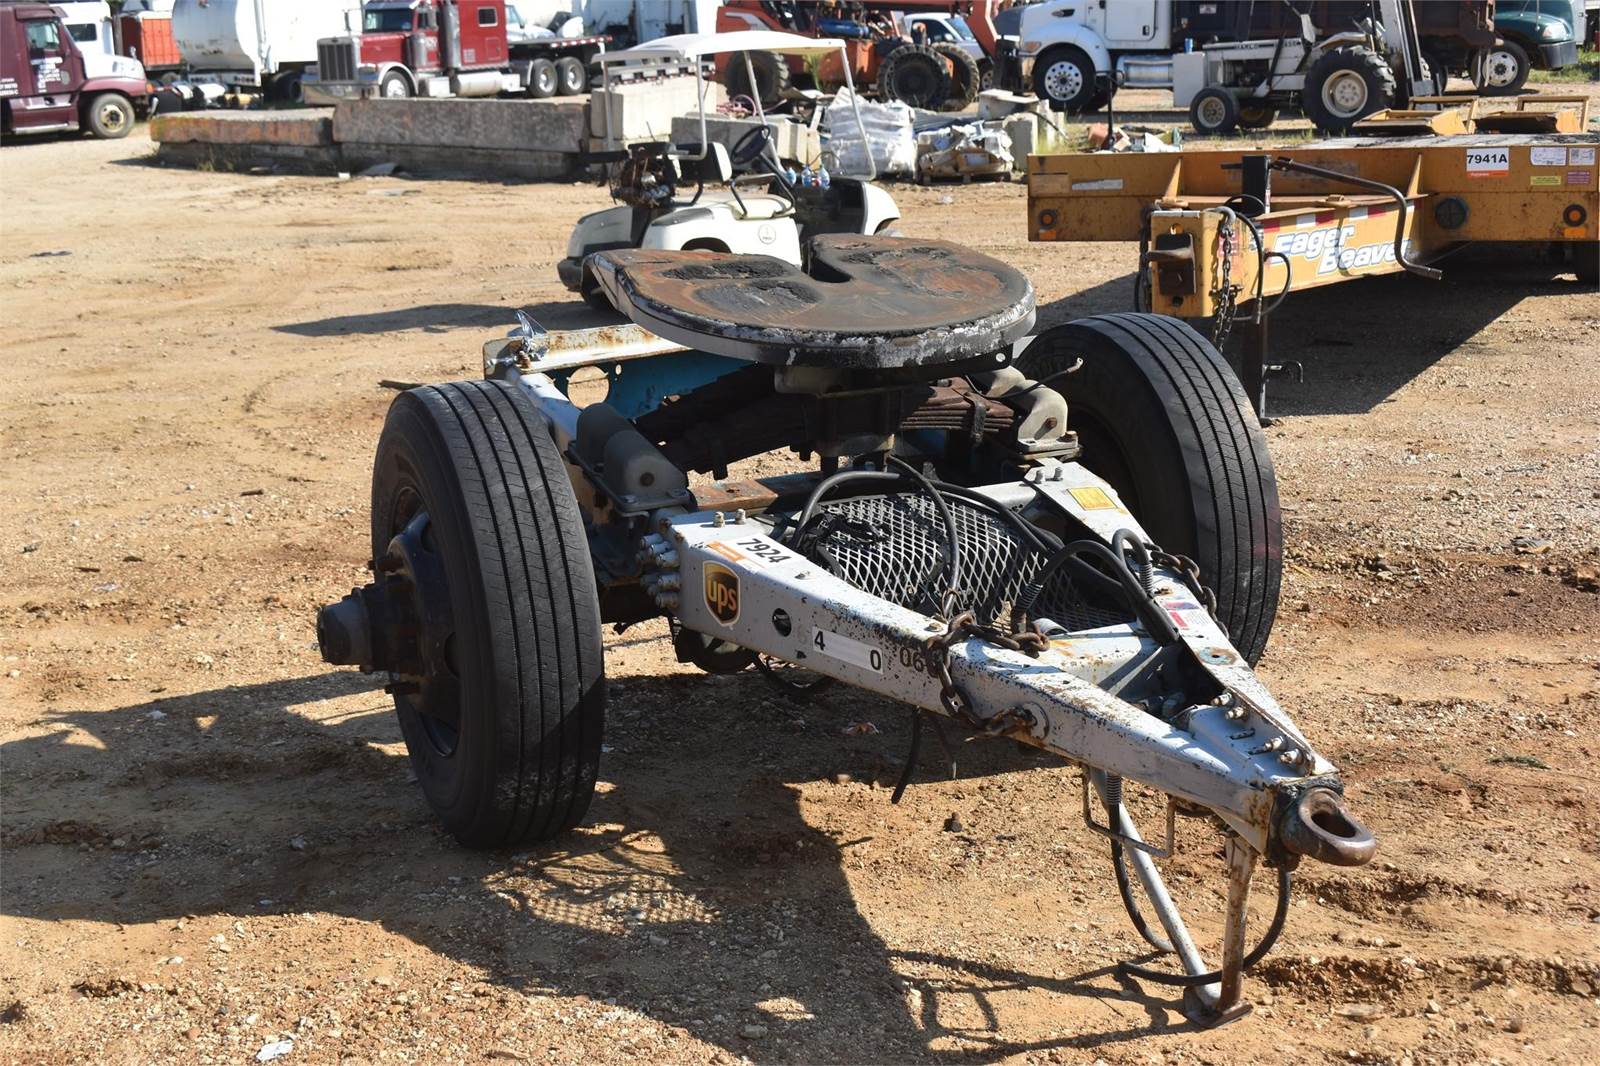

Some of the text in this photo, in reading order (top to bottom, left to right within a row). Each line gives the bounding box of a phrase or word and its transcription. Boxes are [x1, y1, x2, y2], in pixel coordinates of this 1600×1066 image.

[1467, 153, 1507, 164] 7941A
[1271, 225, 1355, 264] Eager
[737, 537, 791, 564] 7924
[707, 579, 737, 614] ups
[814, 630, 826, 651] 4
